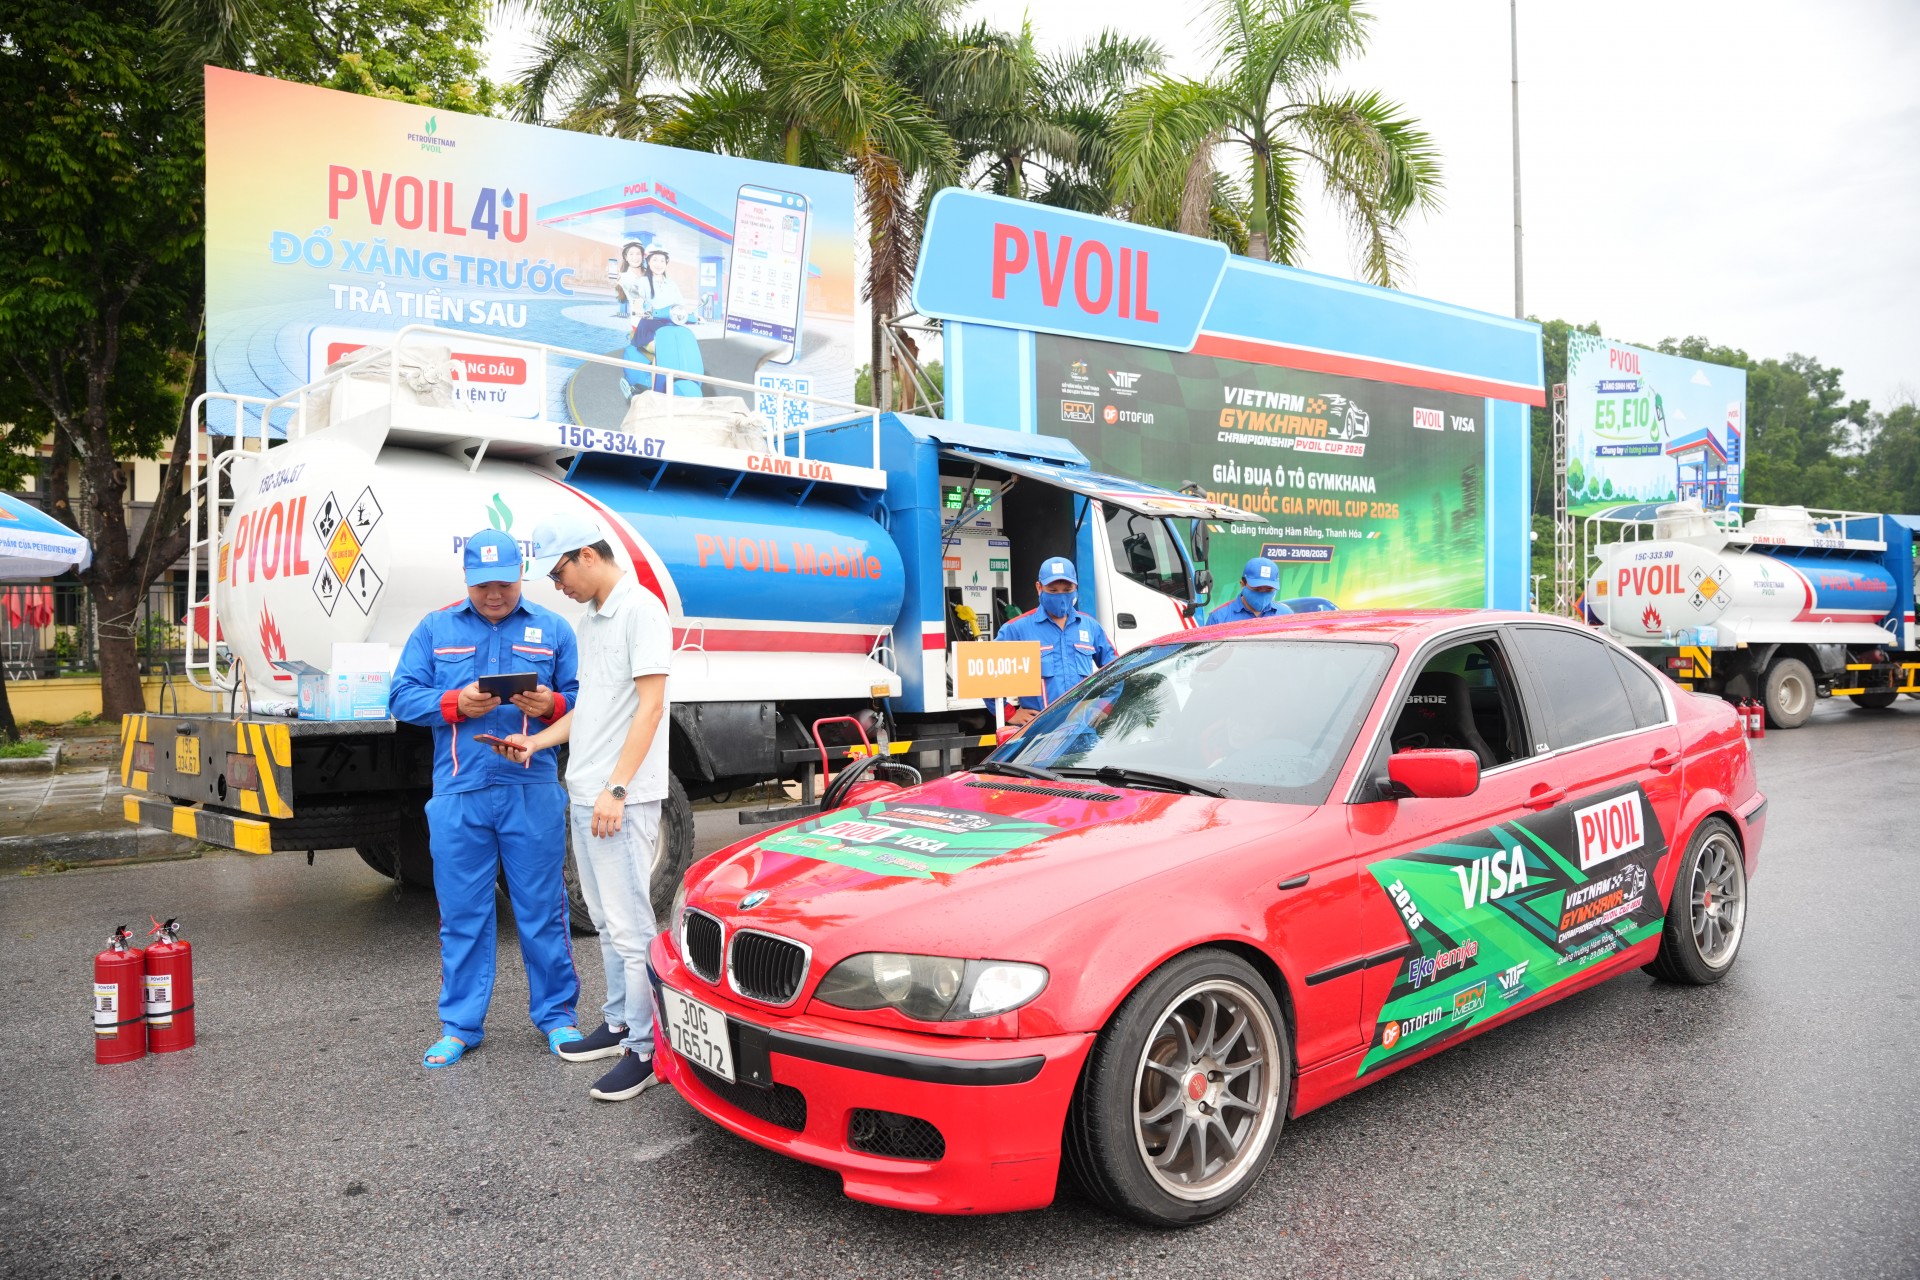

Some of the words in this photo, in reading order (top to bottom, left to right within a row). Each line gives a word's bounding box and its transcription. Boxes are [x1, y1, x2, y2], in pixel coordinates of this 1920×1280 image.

[407, 133, 456, 148] PETROVIETNAM
[421, 143, 442, 154] PVOIL
[623, 182, 649, 196] PVOIL
[269, 225, 334, 269] ĐỔ
[341, 236, 448, 282] XĂNG
[453, 254, 574, 297] TRƯỚC
[991, 222, 1159, 324] PVOIL
[328, 281, 392, 316] TRẢ
[395, 287, 464, 322] TIỀN
[468, 301, 527, 329] SAU
[1610, 348, 1641, 375] PVOIL
[489, 388, 507, 403] TỬ
[1223, 386, 1305, 413] VIETNAM
[1063, 412, 1094, 423] MEDIA
[1119, 410, 1154, 425] OTOFUN
[1219, 408, 1328, 438] GYMKHANA
[1415, 409, 1443, 429] PVOIL
[1450, 415, 1475, 433] VISA
[558, 425, 665, 458] 15C-334.67
[1217, 431, 1295, 449] CHAMPIONSHIP
[1295, 439, 1322, 452] PVOIL
[1324, 442, 1343, 454] CUP
[1344, 444, 1363, 456] 2026
[1213, 460, 1240, 484] GIẢI
[1244, 466, 1273, 486] ĐUA
[1275, 464, 1285, 487] Ô
[1287, 466, 1305, 488] TÔ
[1307, 471, 1376, 494] GYMKHANA
[1242, 487, 1279, 514] QUỐC
[1282, 497, 1304, 515] GIA
[1306, 497, 1343, 518] PVOIL
[1345, 500, 1368, 519] CUP
[1370, 501, 1399, 520] 2026
[231, 495, 310, 588] PVOIL
[1230, 523, 1256, 538] Quảng
[1258, 524, 1284, 538] trường
[1285, 525, 1303, 537] Hàm
[1325, 527, 1348, 538] Thanh
[1348, 528, 1363, 539] Hóa
[32, 542, 77, 556] PETROVIETNAM
[694, 533, 789, 573] PVOIL
[791, 542, 882, 580] Mobile
[1267, 548, 1287, 558] 22/08
[1292, 548, 1328, 559] 23/08/2026
[1634, 550, 1674, 561] 15C-333.90
[1618, 563, 1686, 597] PVOIL
[1819, 575, 1854, 591] PVOIL
[968, 658, 984, 677] DO
[986, 656, 1030, 678] 0,001-V
[819, 822, 888, 840] PVOIL
[894, 834, 950, 853] VISA
[1580, 800, 1640, 861] PVOIL
[1450, 845, 1528, 910] VISA
[1386, 879, 1424, 930] 2026
[1565, 877, 1611, 910] VIETNAM
[1560, 889, 1624, 931] GYMKHANA
[1408, 938, 1478, 989] Ekokemika
[1579, 956, 1587, 965] 22
[679, 998, 708, 1035] 30G
[1455, 998, 1485, 1017] MEDIA
[1401, 1006, 1443, 1037] OTOFUN
[673, 1024, 726, 1074] 765.72
